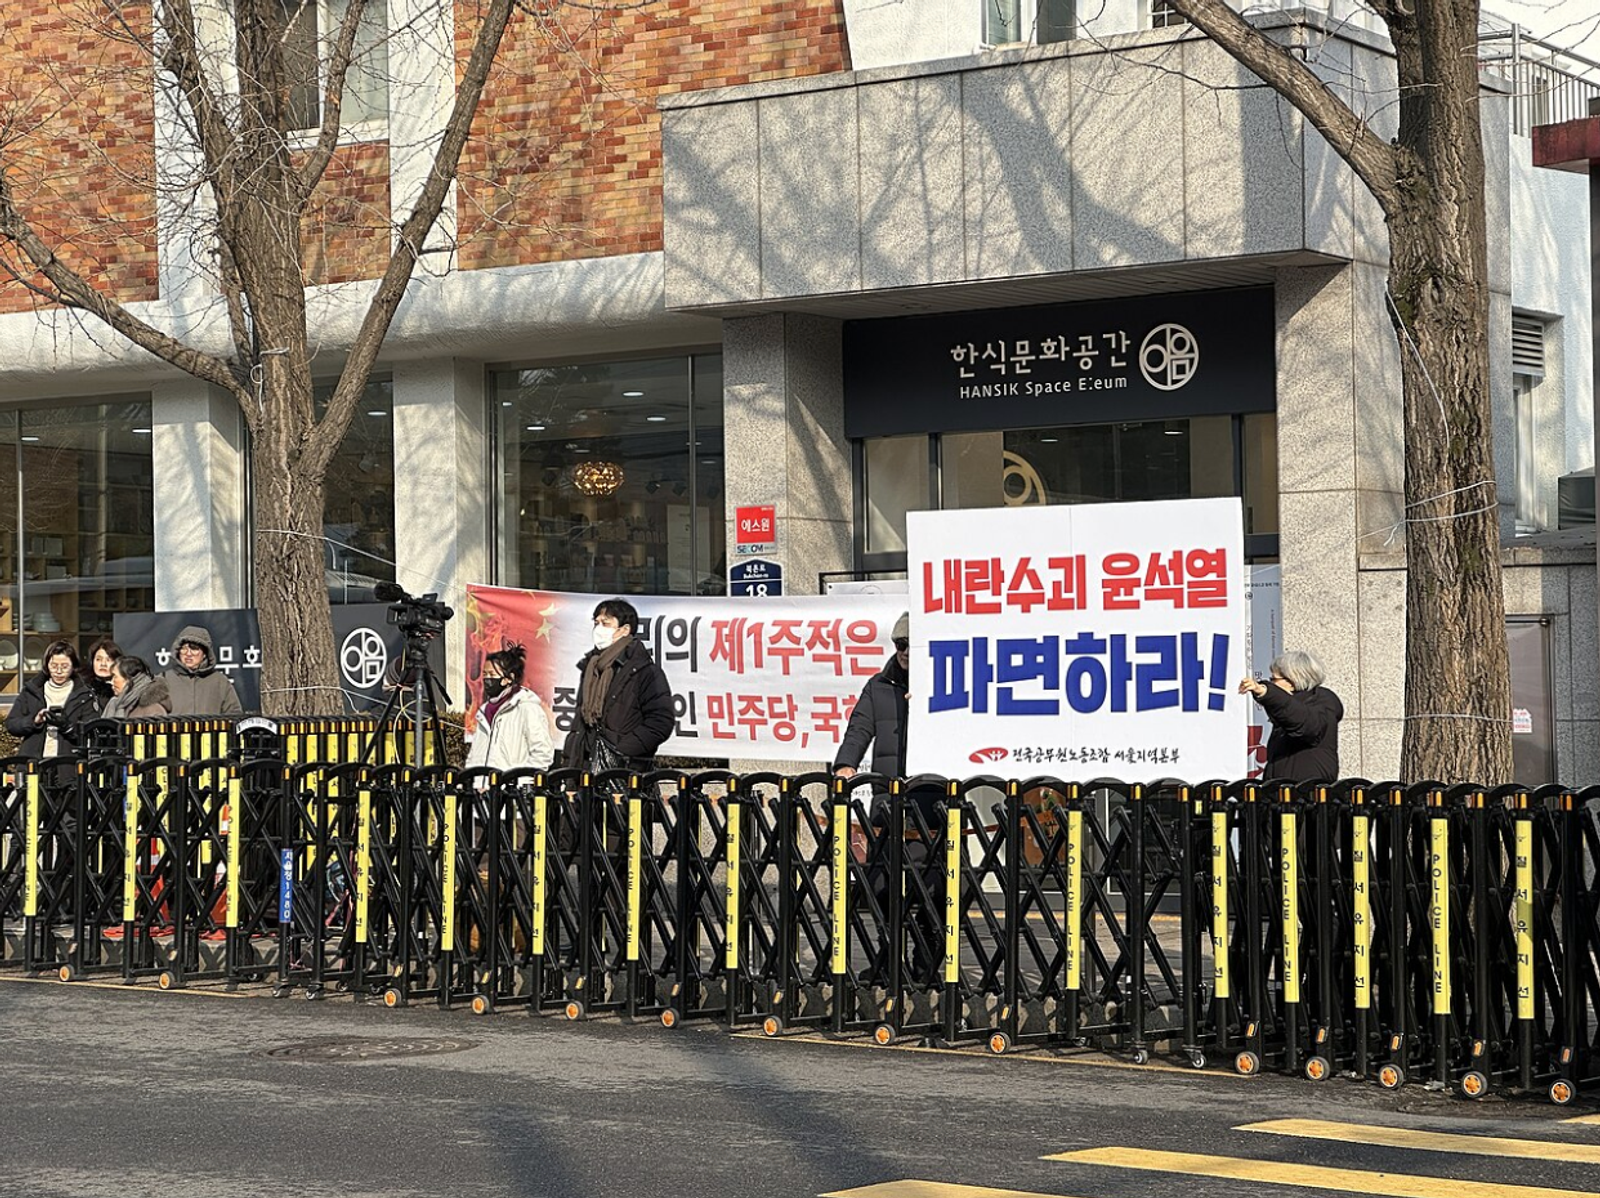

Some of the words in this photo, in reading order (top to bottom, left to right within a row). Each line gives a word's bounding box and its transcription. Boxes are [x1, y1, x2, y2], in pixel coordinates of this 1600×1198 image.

[951, 330, 1131, 379] 한식문화공간
[959, 382, 1020, 400] HANSIK
[1025, 378, 1072, 398] Space
[1078, 374, 1128, 392] E:eum
[742, 518, 769, 533] 에스원
[745, 583, 768, 597] 18
[922, 553, 1088, 615] 내란수괴
[1101, 547, 1229, 612] 윤석열
[708, 617, 885, 676] 제1주적은
[927, 631, 1231, 717] 파면하라!
[552, 686, 699, 738] 중인
[1012, 746, 1110, 764] 전국공무원노동조합
[1114, 747, 1182, 764] 서울지역본부
[833, 836, 841, 901] POLICE
[1067, 843, 1076, 912] POLICE
[1281, 847, 1290, 920] POLICE
[1432, 854, 1442, 929] POLICE
[832, 914, 840, 957] LINE
[1353, 850, 1365, 988] 질서유지선
[1516, 856, 1529, 998] 질서유지선
[1283, 935, 1291, 982] LINE
[1434, 944, 1442, 993] LINE
